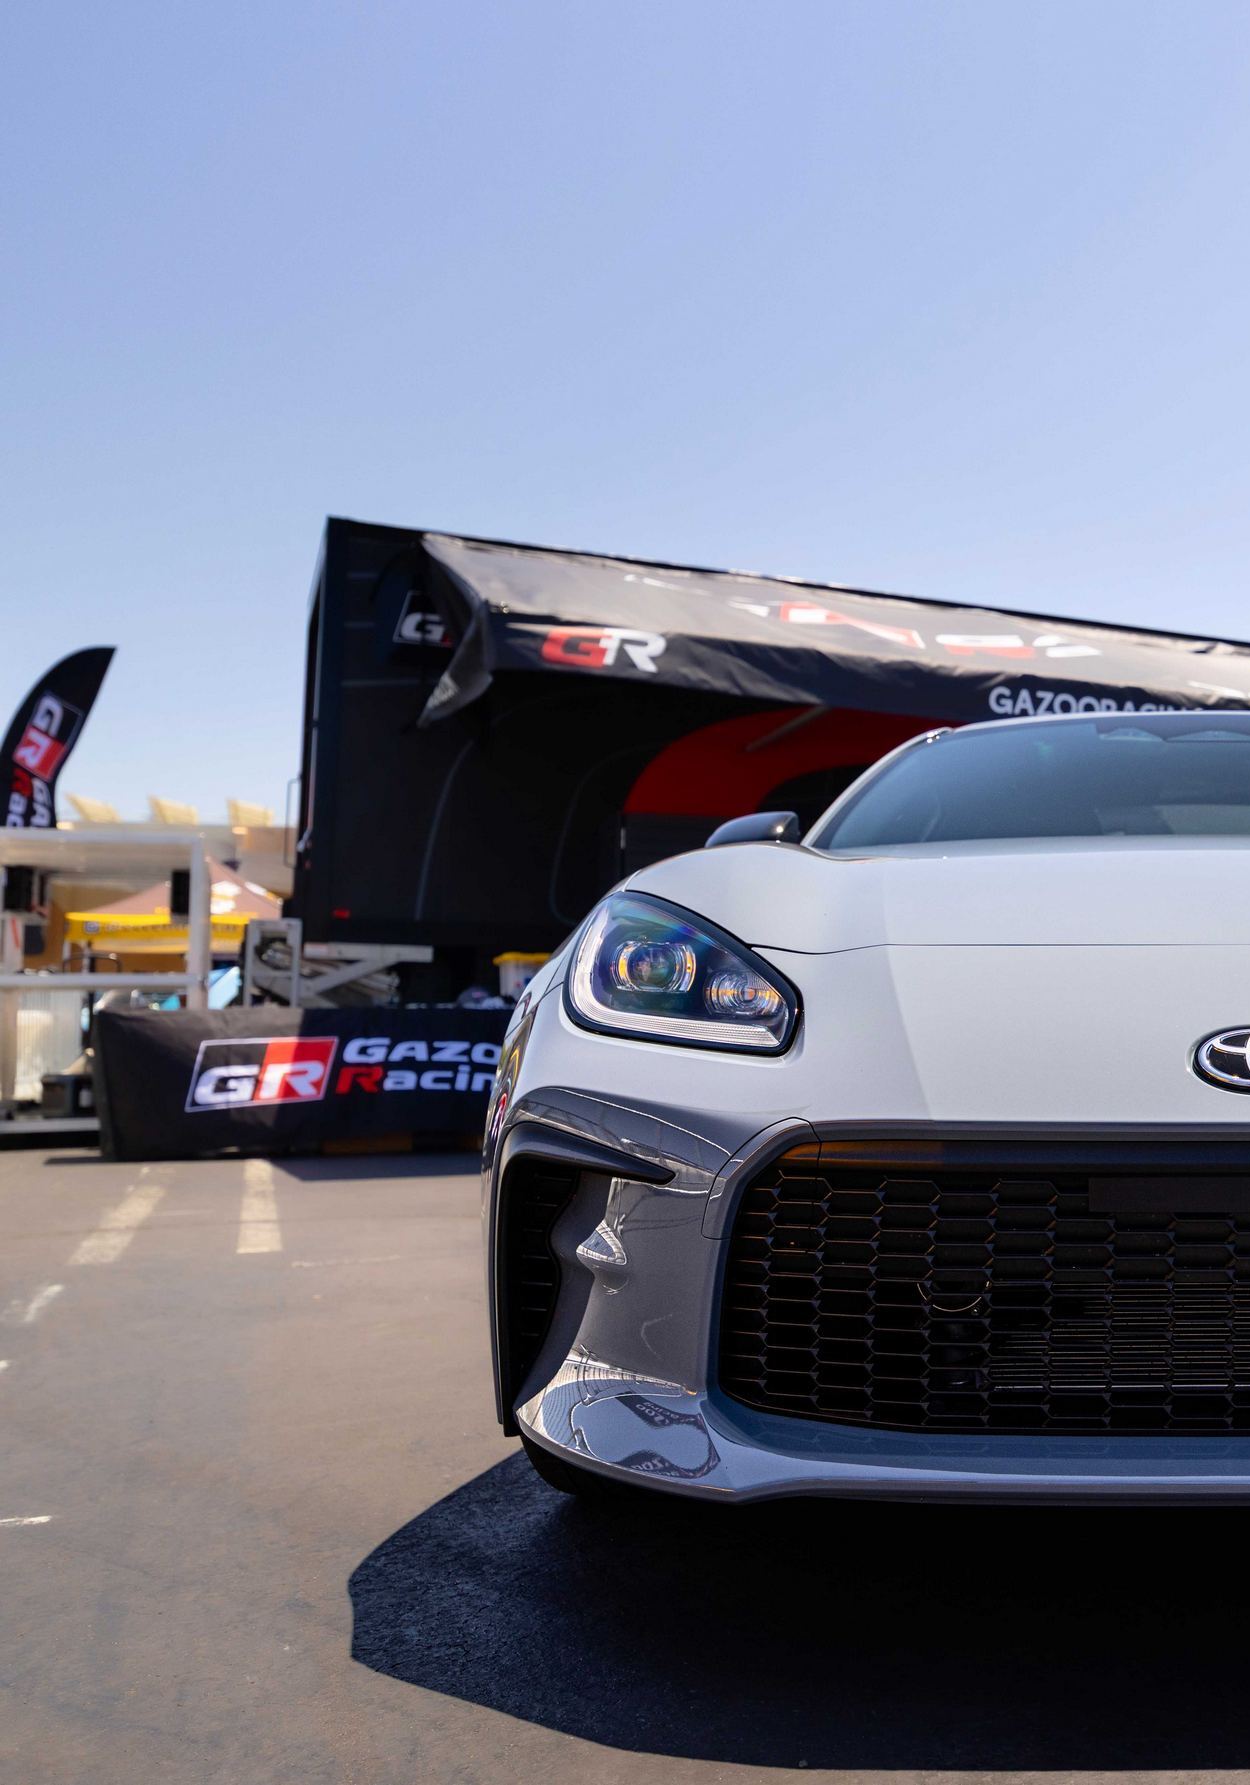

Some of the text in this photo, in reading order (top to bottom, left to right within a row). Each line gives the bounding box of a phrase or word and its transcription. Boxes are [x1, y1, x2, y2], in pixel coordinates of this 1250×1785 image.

[401, 612, 449, 641] G
[541, 627, 667, 673] GR
[17, 694, 64, 767] GR
[193, 1060, 326, 1105] GR
